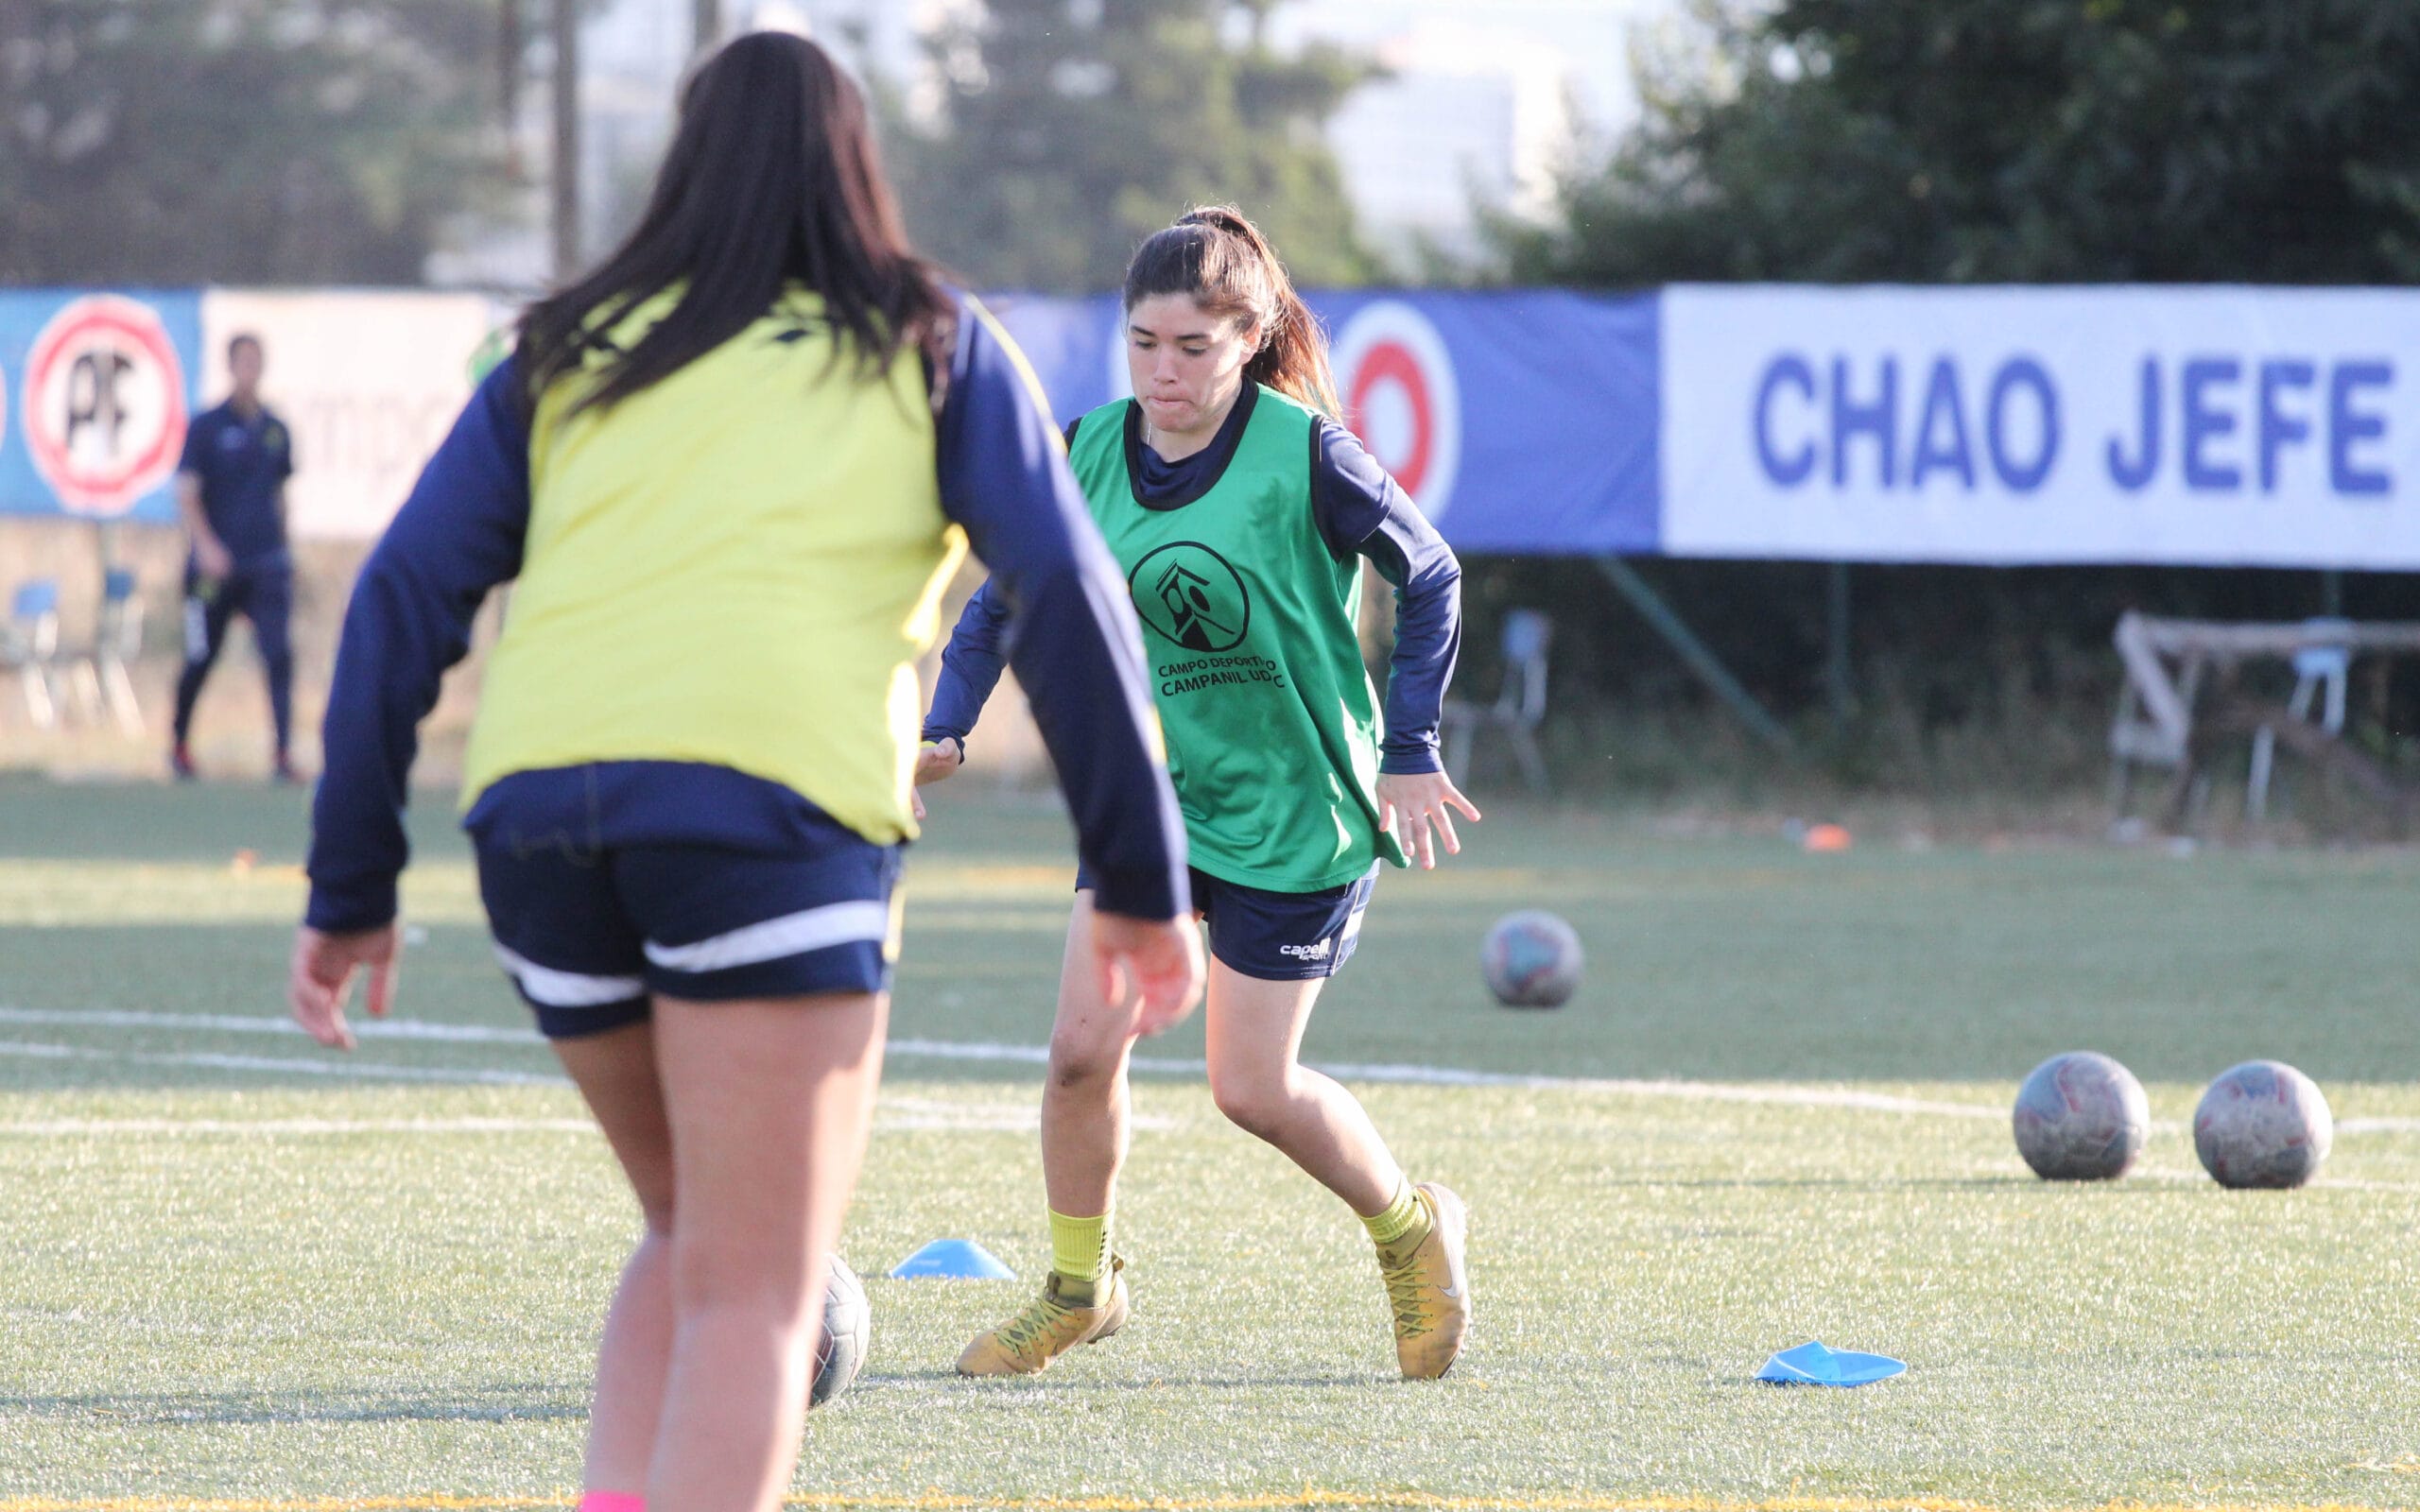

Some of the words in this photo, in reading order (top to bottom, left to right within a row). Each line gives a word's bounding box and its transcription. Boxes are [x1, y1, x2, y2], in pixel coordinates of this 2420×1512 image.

[1753, 352, 2062, 493] CHAO
[2106, 353, 2395, 496] JEFE
[1158, 659, 1208, 678] CAMPO
[1209, 656, 1276, 671] DEPORTIO
[1161, 671, 1248, 696] CAMPANIL
[1279, 936, 1331, 960] capell
